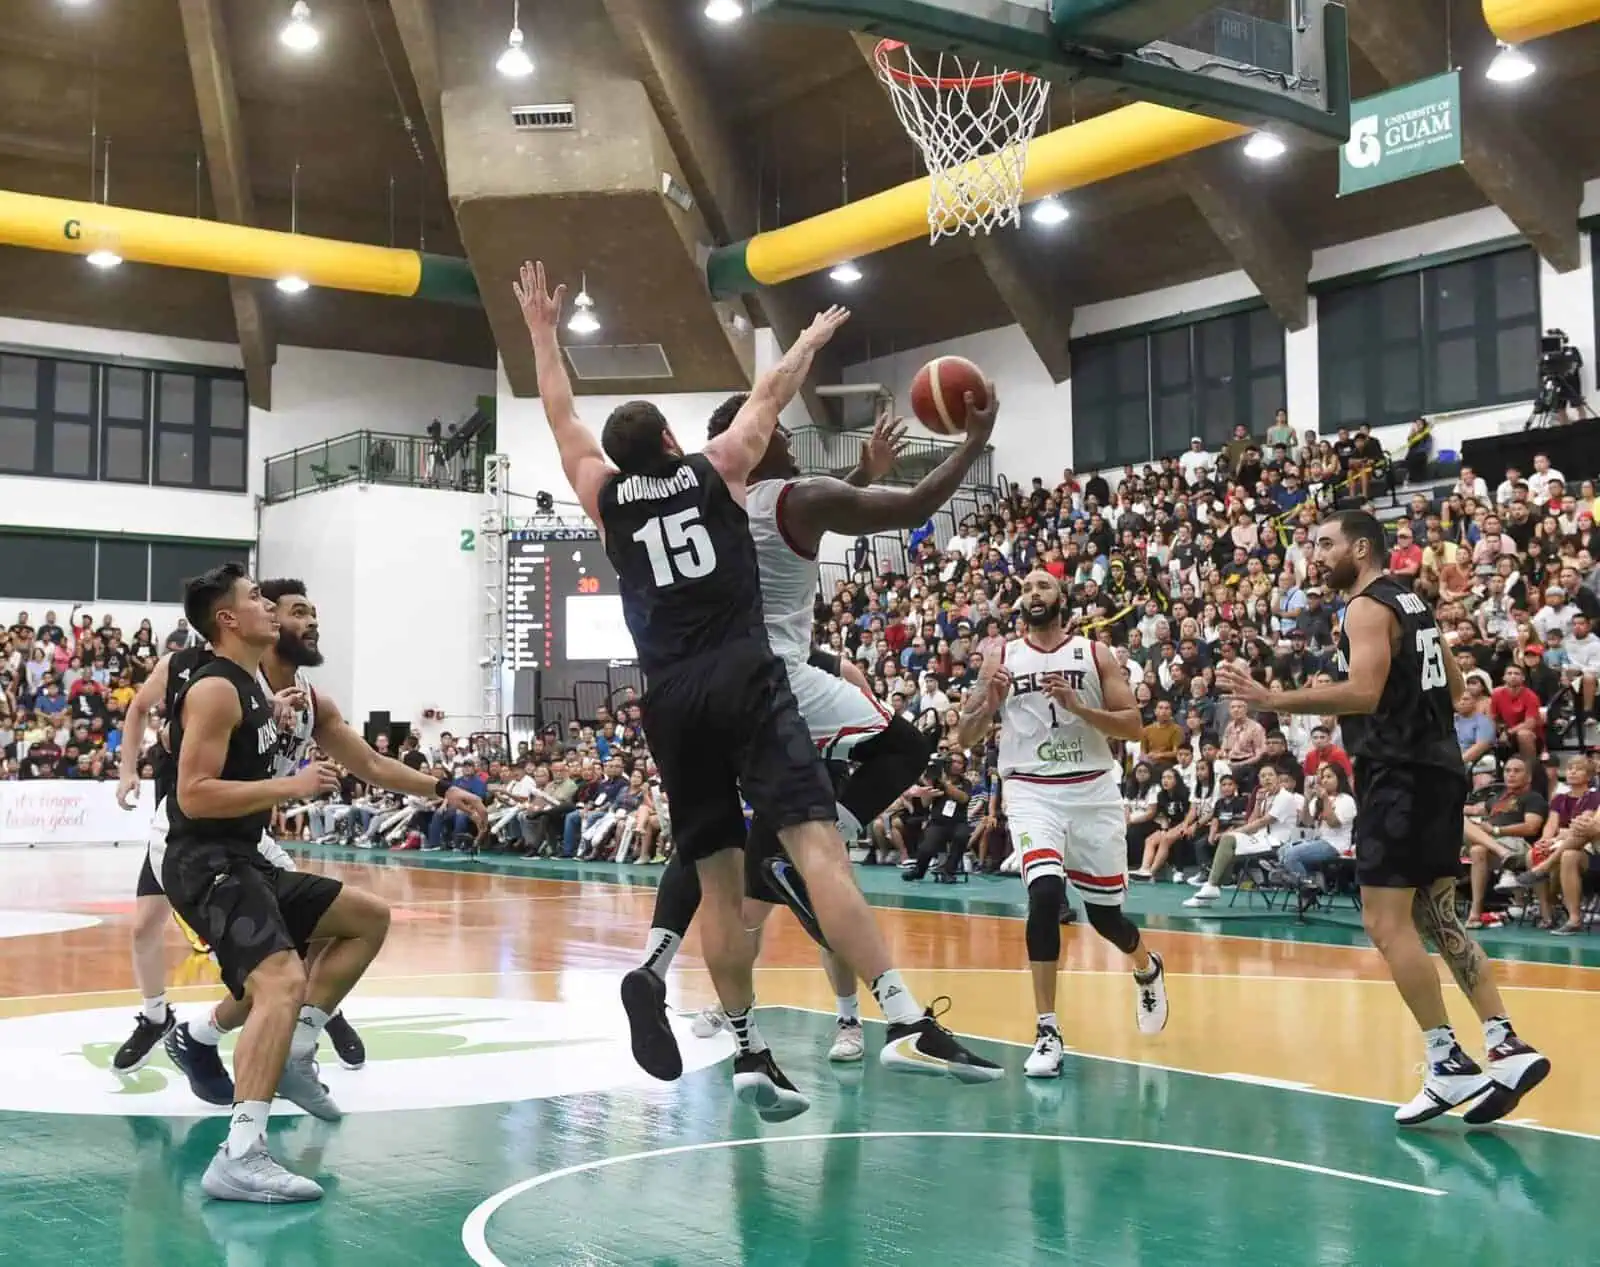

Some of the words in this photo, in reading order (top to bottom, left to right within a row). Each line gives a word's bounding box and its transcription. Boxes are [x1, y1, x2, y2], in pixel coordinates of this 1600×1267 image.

[1385, 110, 1452, 147] GUAM
[461, 529, 475, 551] 2
[632, 506, 717, 588] 15
[1416, 628, 1447, 691] 25
[1011, 669, 1087, 697] GUM
[1048, 702, 1059, 729] 1
